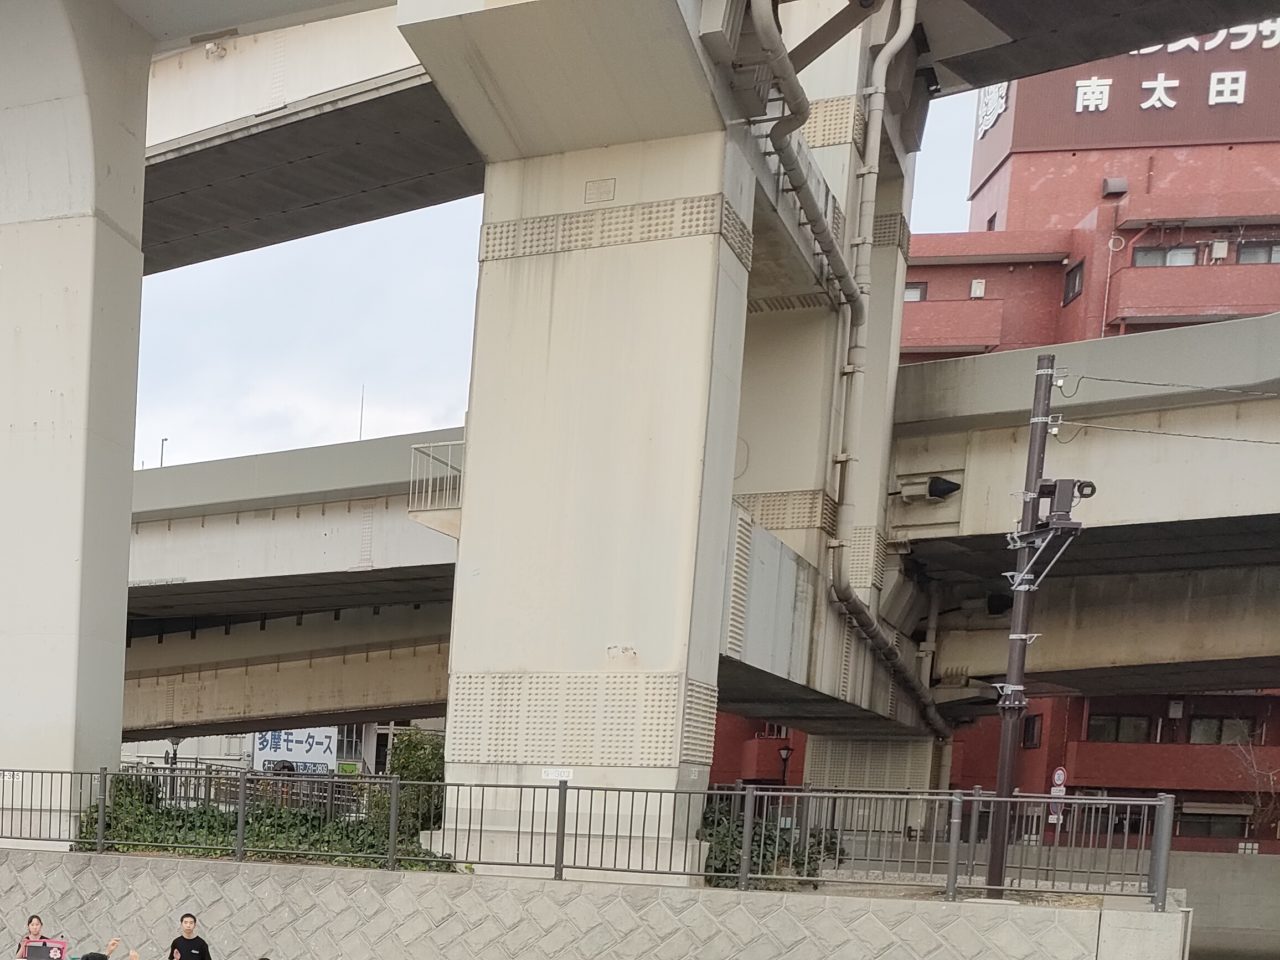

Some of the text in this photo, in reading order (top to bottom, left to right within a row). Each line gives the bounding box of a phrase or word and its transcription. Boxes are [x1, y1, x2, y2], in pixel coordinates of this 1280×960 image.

[1075, 71, 1246, 112] 南太田
[258, 731, 333, 755] 多摩モータース
